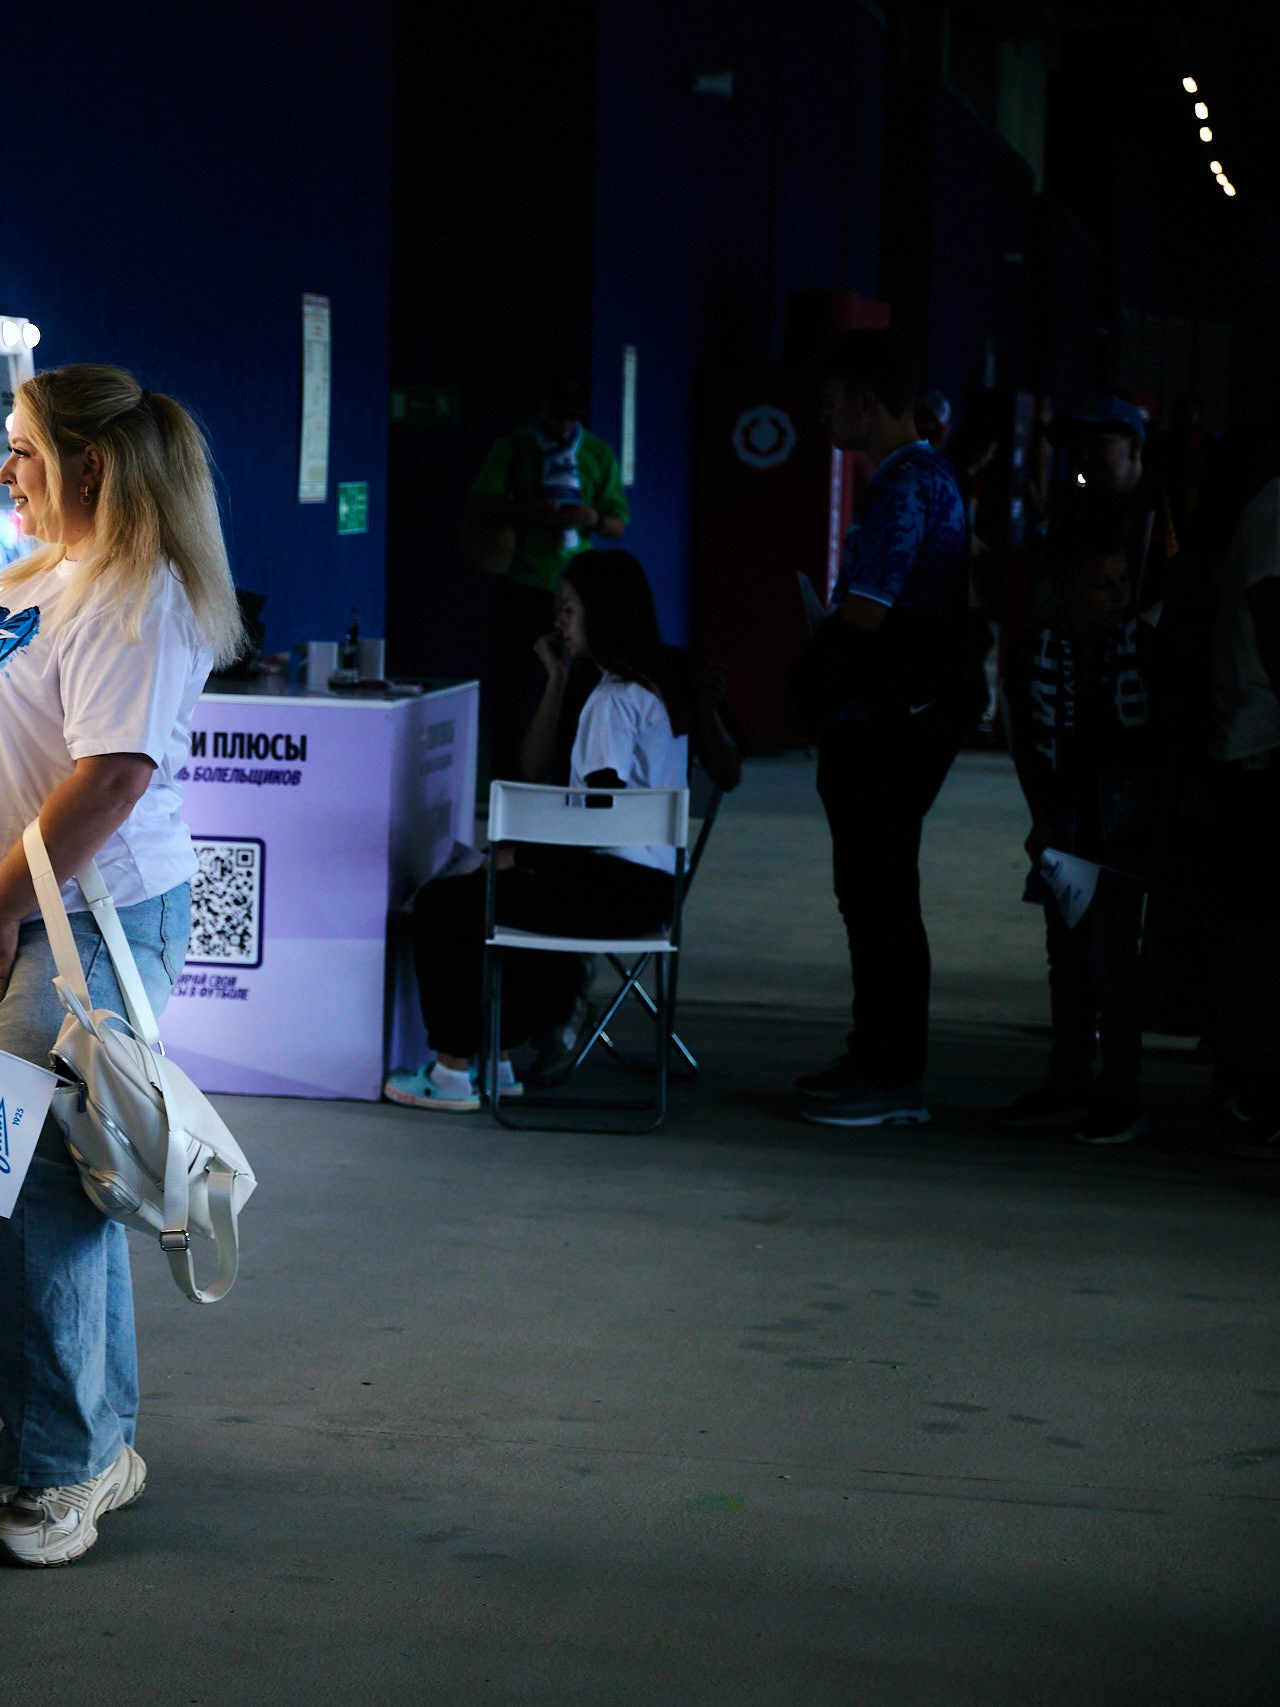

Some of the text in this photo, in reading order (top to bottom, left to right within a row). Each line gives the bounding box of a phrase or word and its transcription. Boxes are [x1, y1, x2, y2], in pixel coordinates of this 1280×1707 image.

[190, 731, 307, 762] И ПЛЮСЫ
[193, 766, 302, 787] БОЛЕЛЬЩИКОВ
[12, 1107, 24, 1126] 1925
